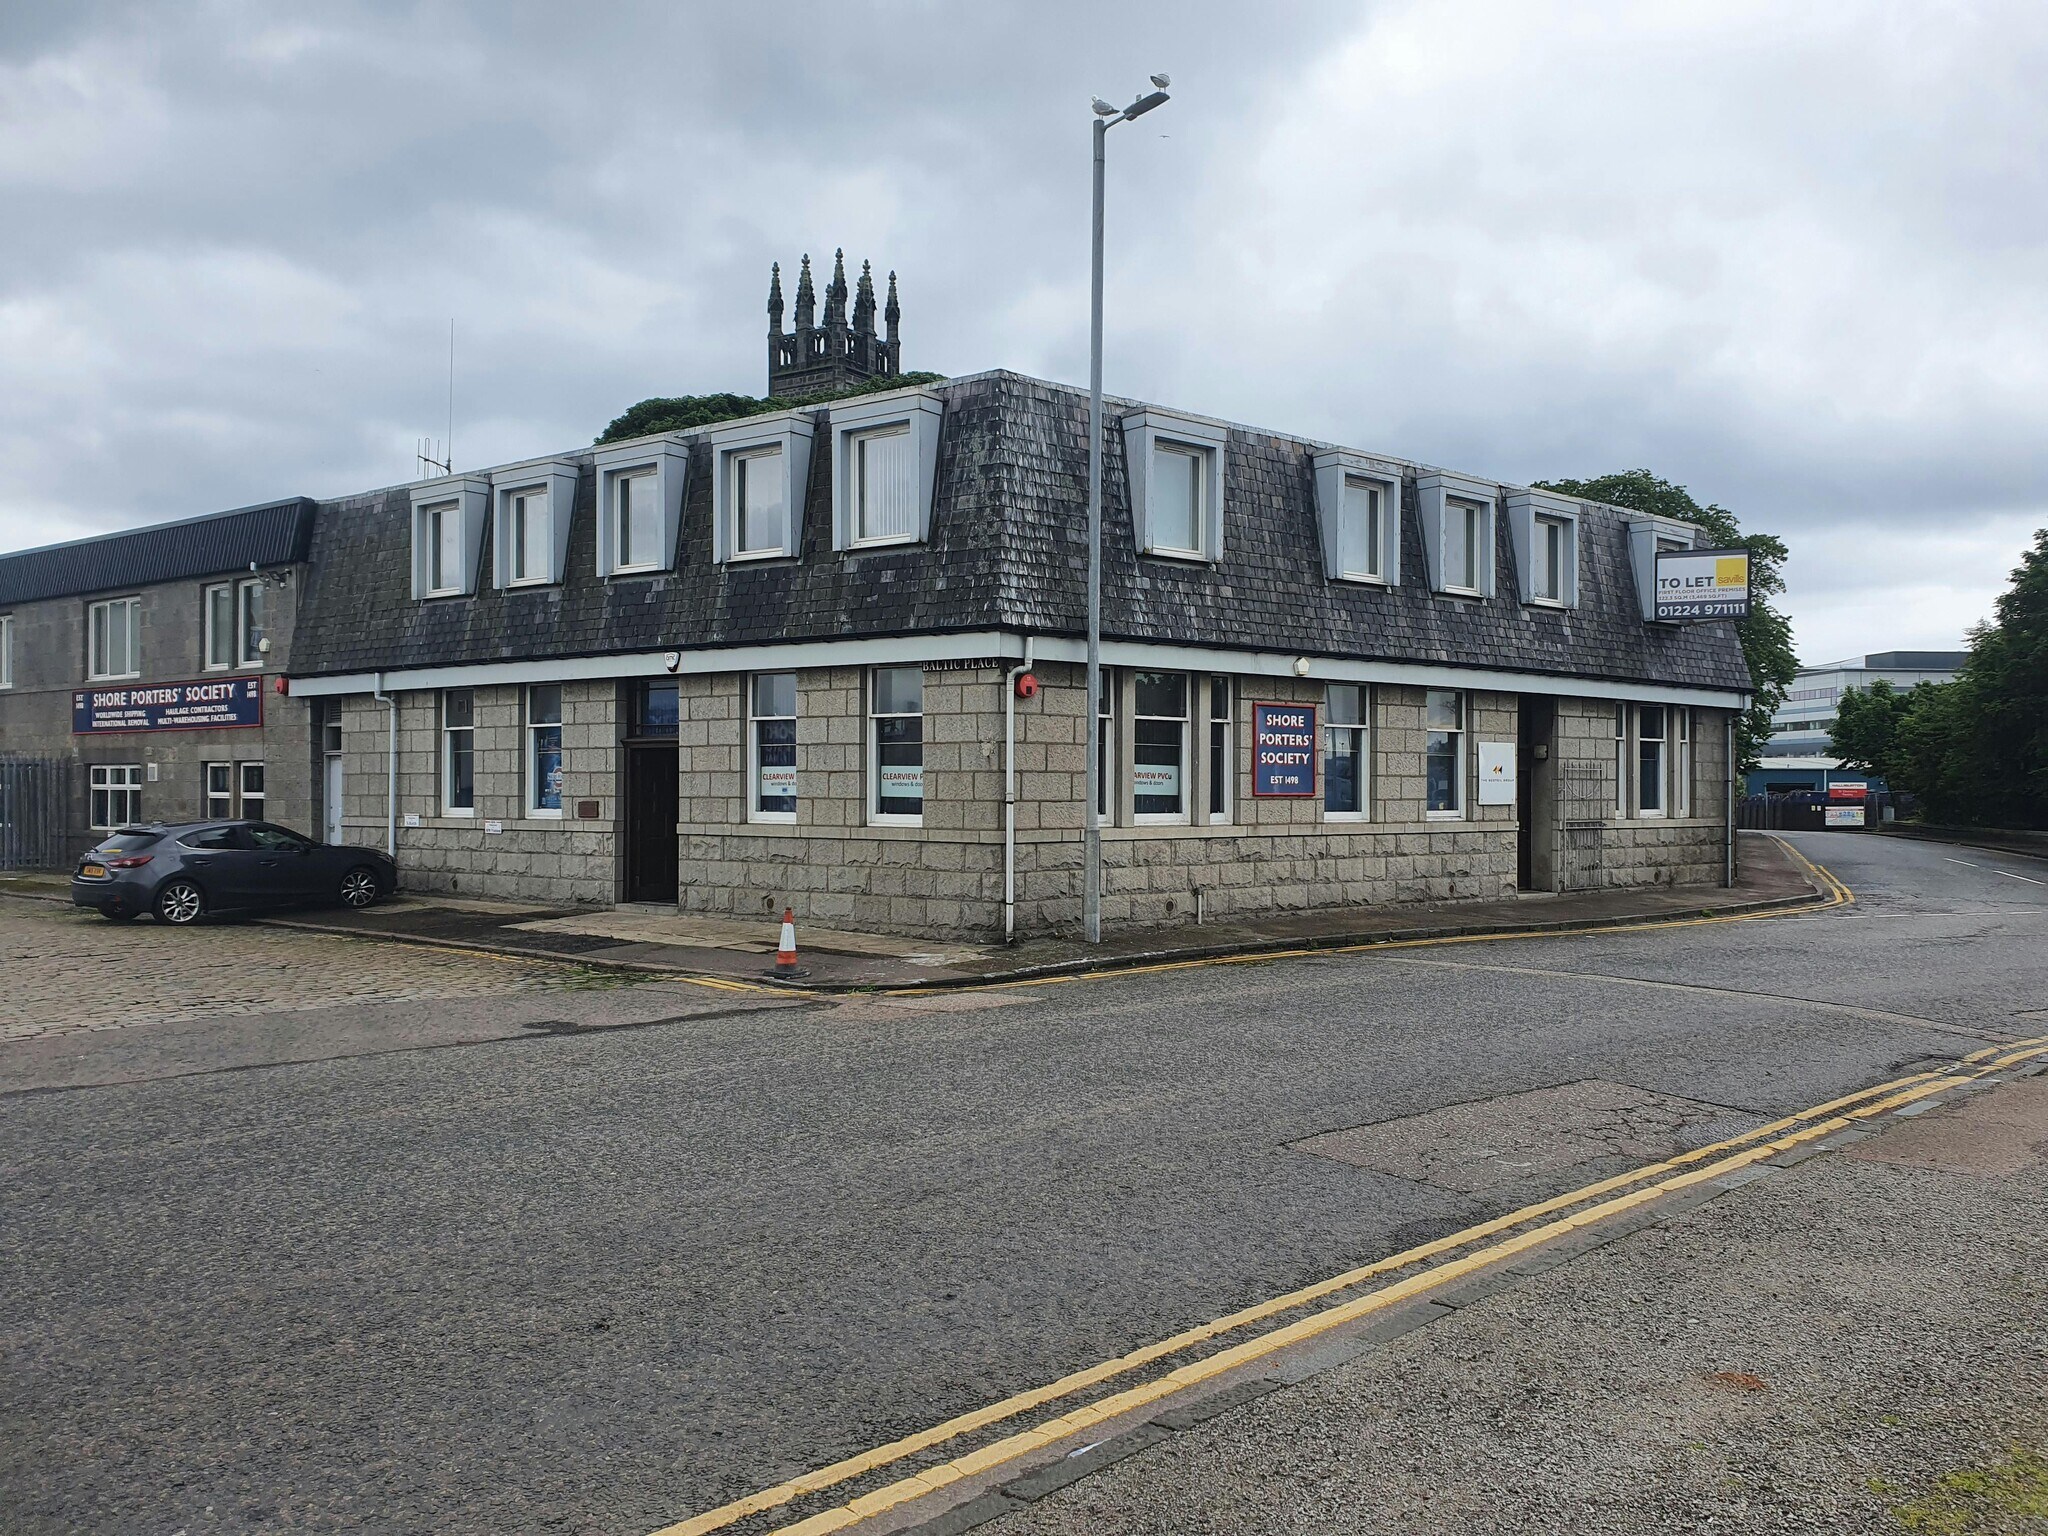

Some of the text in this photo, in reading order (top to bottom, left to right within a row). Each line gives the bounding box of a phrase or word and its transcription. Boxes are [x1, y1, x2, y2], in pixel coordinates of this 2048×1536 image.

[1659, 576, 1714, 589] TO LET
[1718, 574, 1744, 584] savills
[1658, 604, 1745, 616] 01224 971111
[923, 658, 998, 671] BALTIC PLACE
[93, 692, 127, 707] SHORE
[186, 683, 235, 702] SOCIETY
[165, 704, 228, 715] HAULAGE CONTRACTORS
[211, 713, 237, 722] FACILITIES
[1266, 714, 1305, 727] SHORE
[1261, 752, 1310, 764] SOCIETY
[1270, 776, 1299, 784] EST 1498
